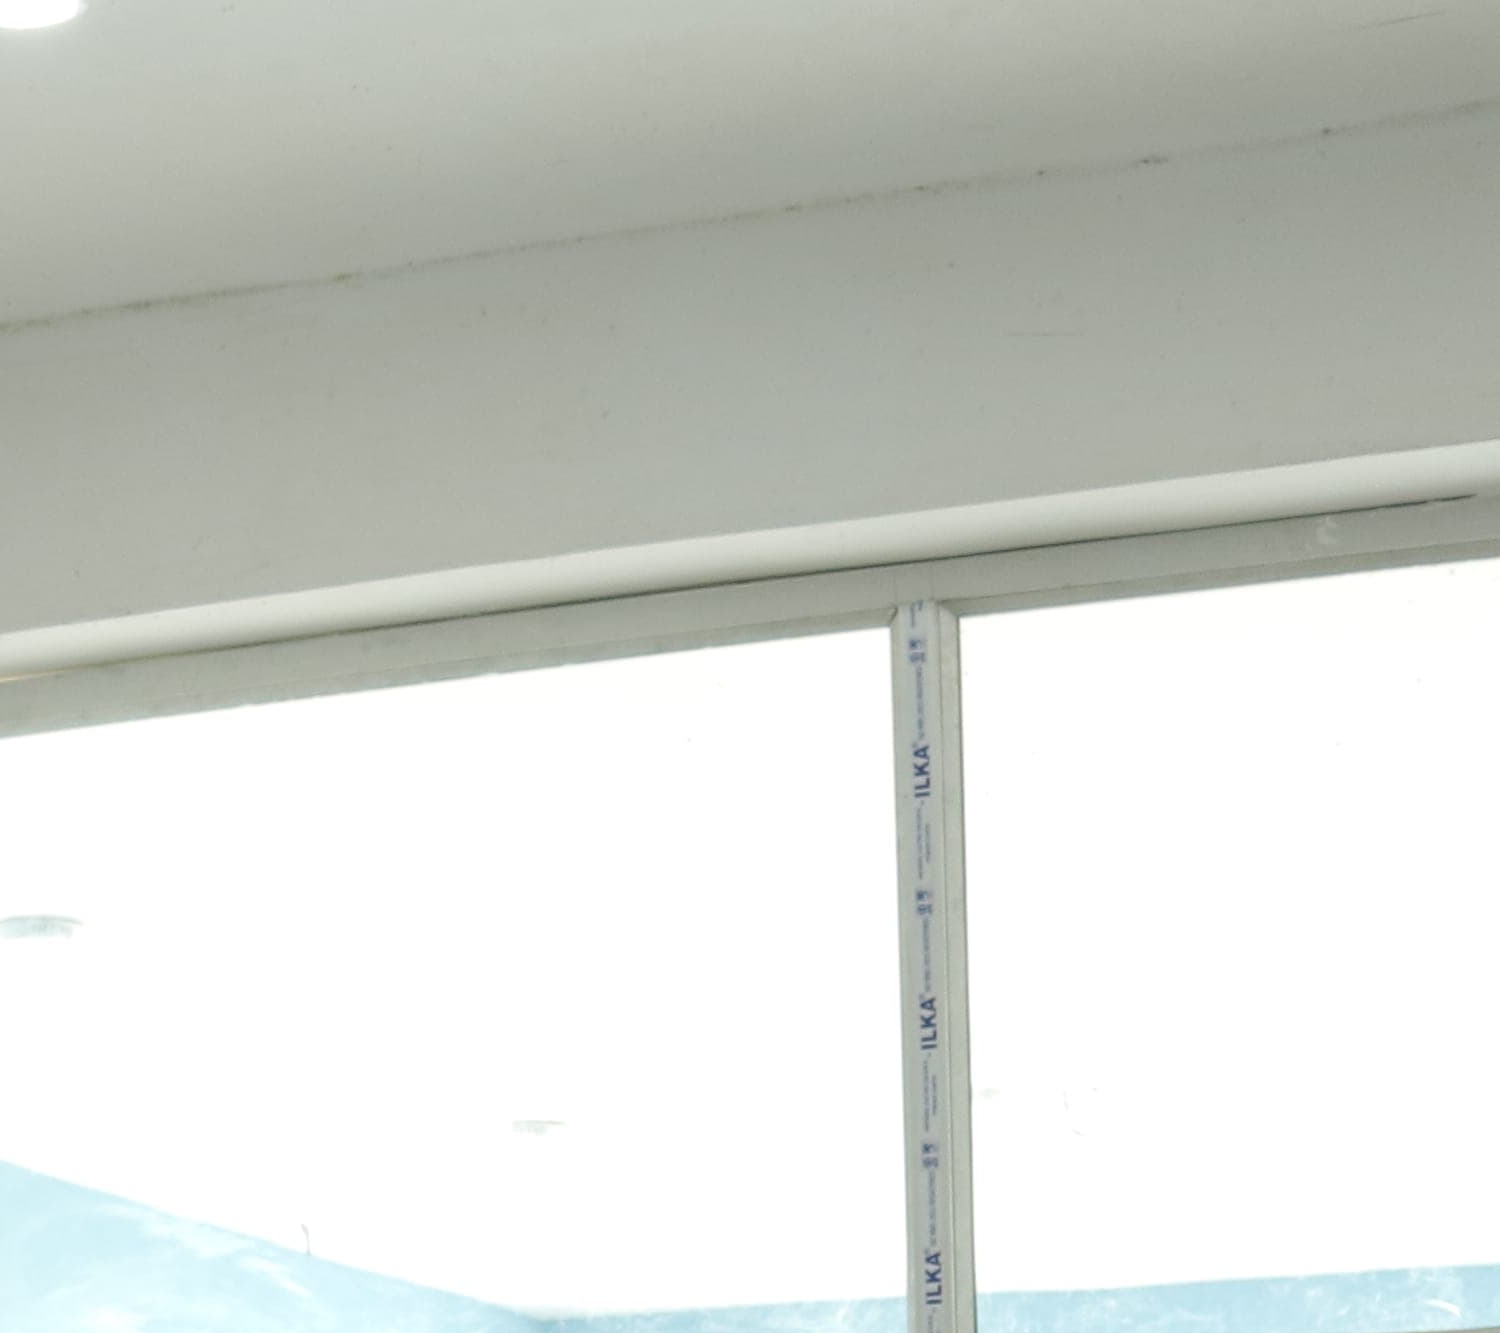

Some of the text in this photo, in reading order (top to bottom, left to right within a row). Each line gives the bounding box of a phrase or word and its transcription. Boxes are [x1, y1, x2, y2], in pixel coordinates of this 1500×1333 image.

[913, 746, 930, 798] ILKA
[920, 998, 937, 1050] ILKA
[925, 1253, 942, 1304] ILKA
